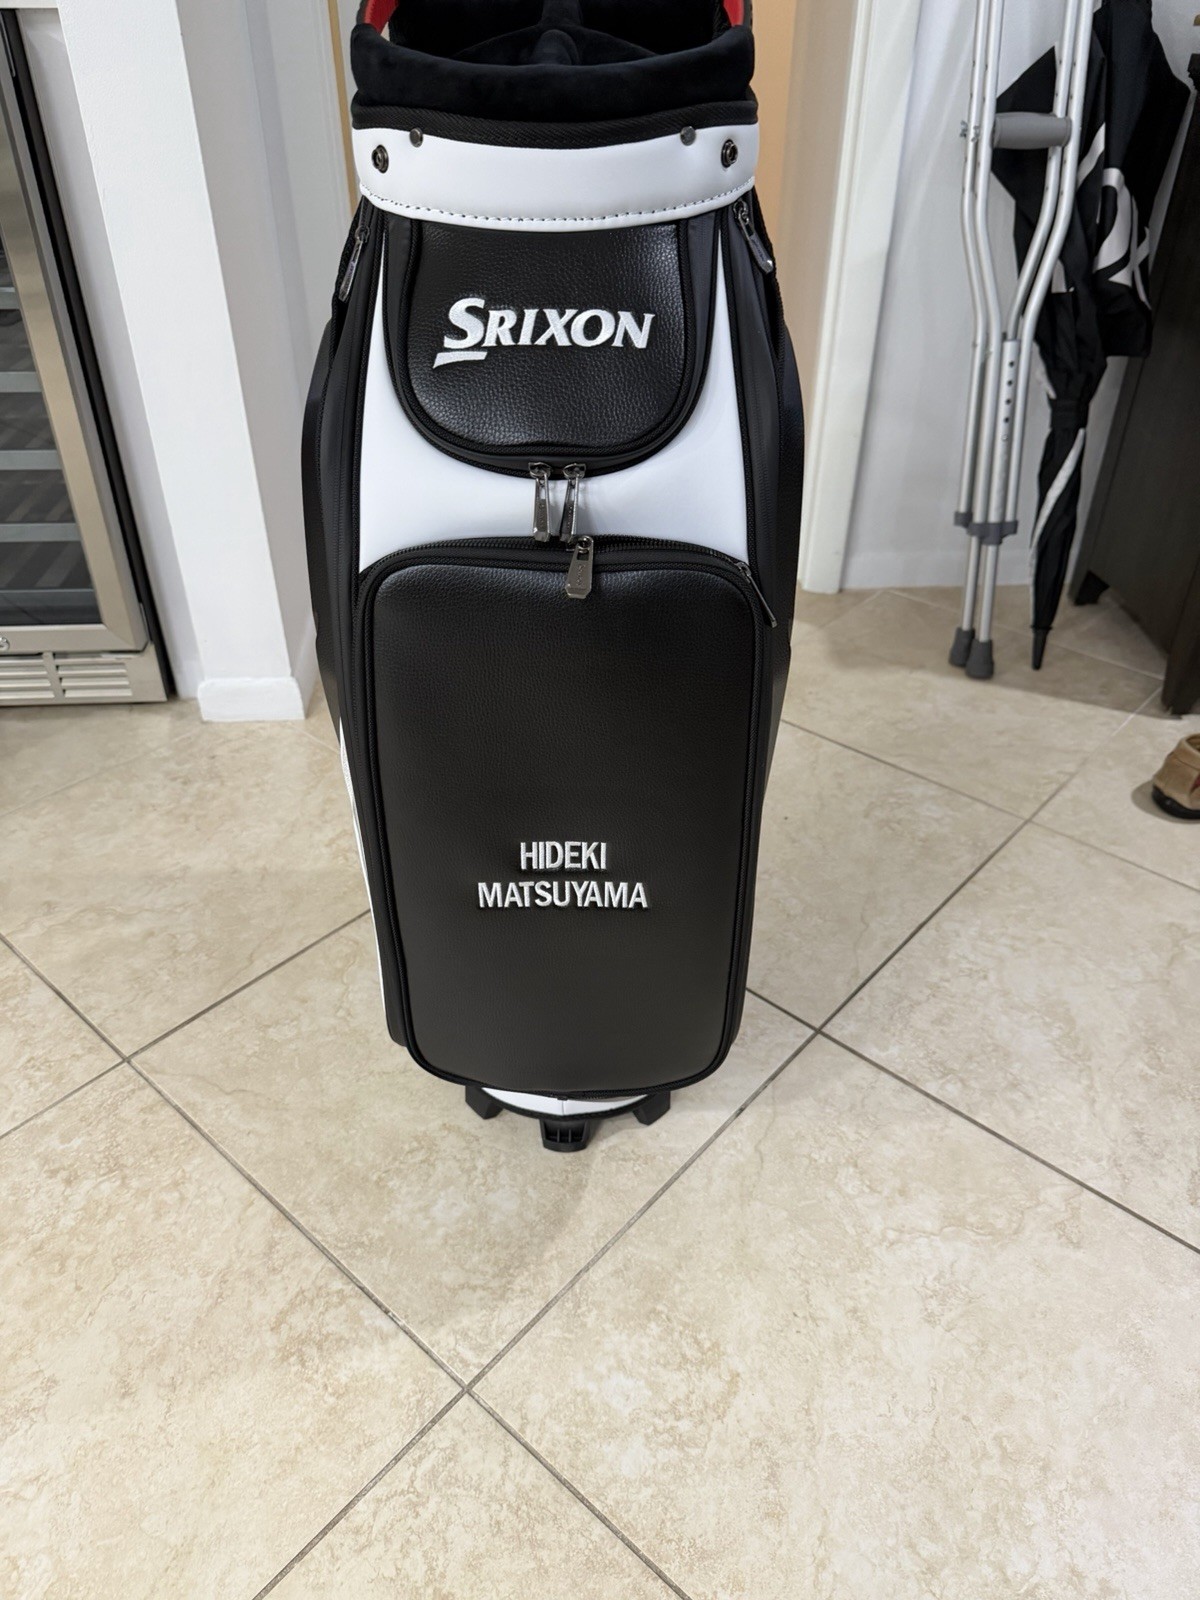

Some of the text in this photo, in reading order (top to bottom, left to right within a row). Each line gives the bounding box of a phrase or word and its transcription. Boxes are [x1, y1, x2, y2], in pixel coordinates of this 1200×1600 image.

[440, 297, 655, 352] SRIXON
[520, 841, 607, 870] HIDEKI
[477, 880, 648, 908] MATSUYAMA
